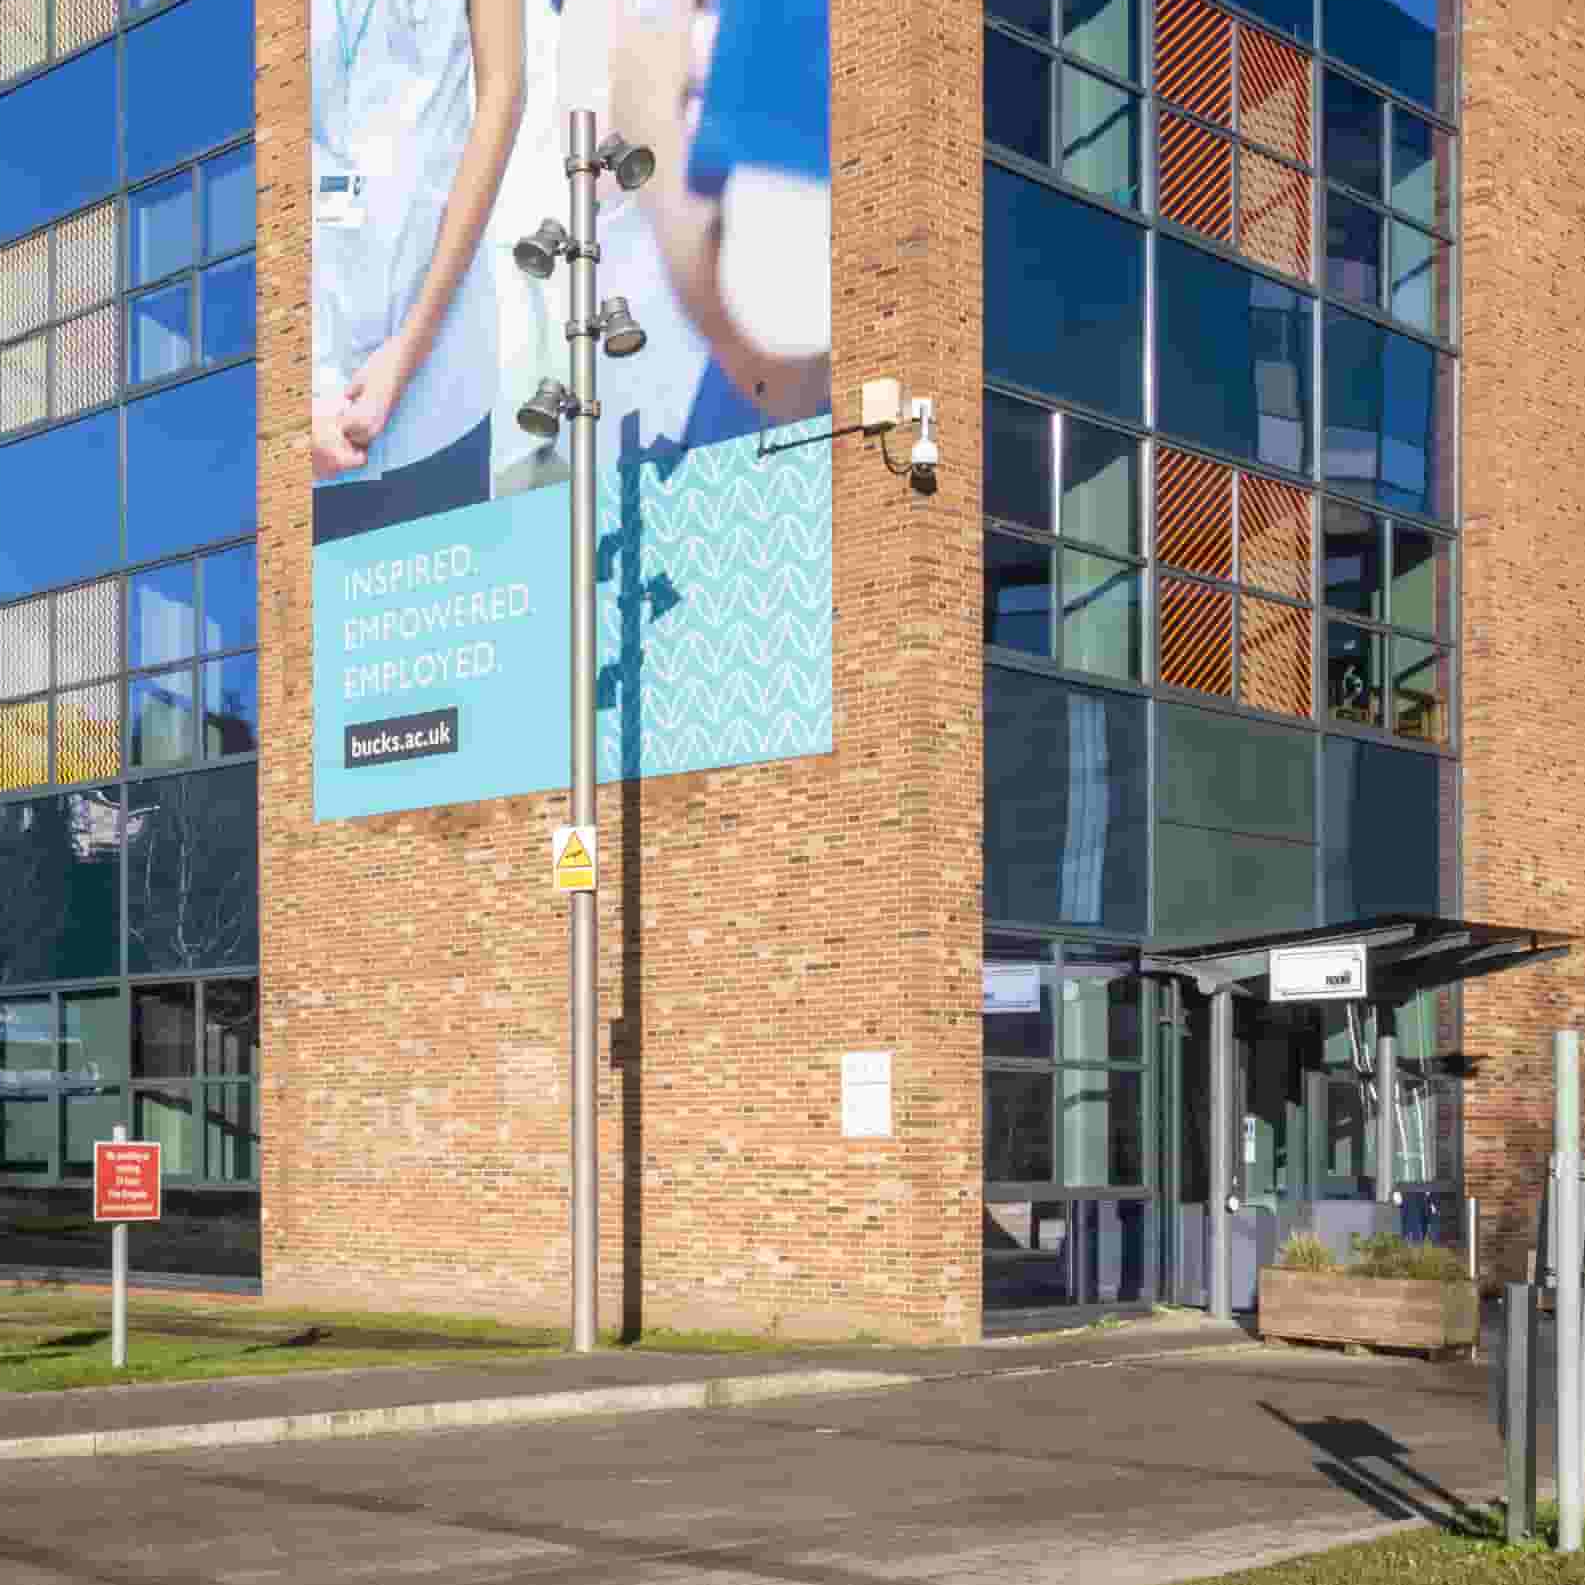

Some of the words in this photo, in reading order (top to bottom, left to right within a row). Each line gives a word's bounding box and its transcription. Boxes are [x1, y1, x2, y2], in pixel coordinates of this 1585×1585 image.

[344, 544, 480, 600] INSPIRED.
[344, 583, 537, 651] EMPOWERED.
[344, 641, 503, 699] EMPLOYED.
[351, 720, 451, 757] bucks.ac.uk
